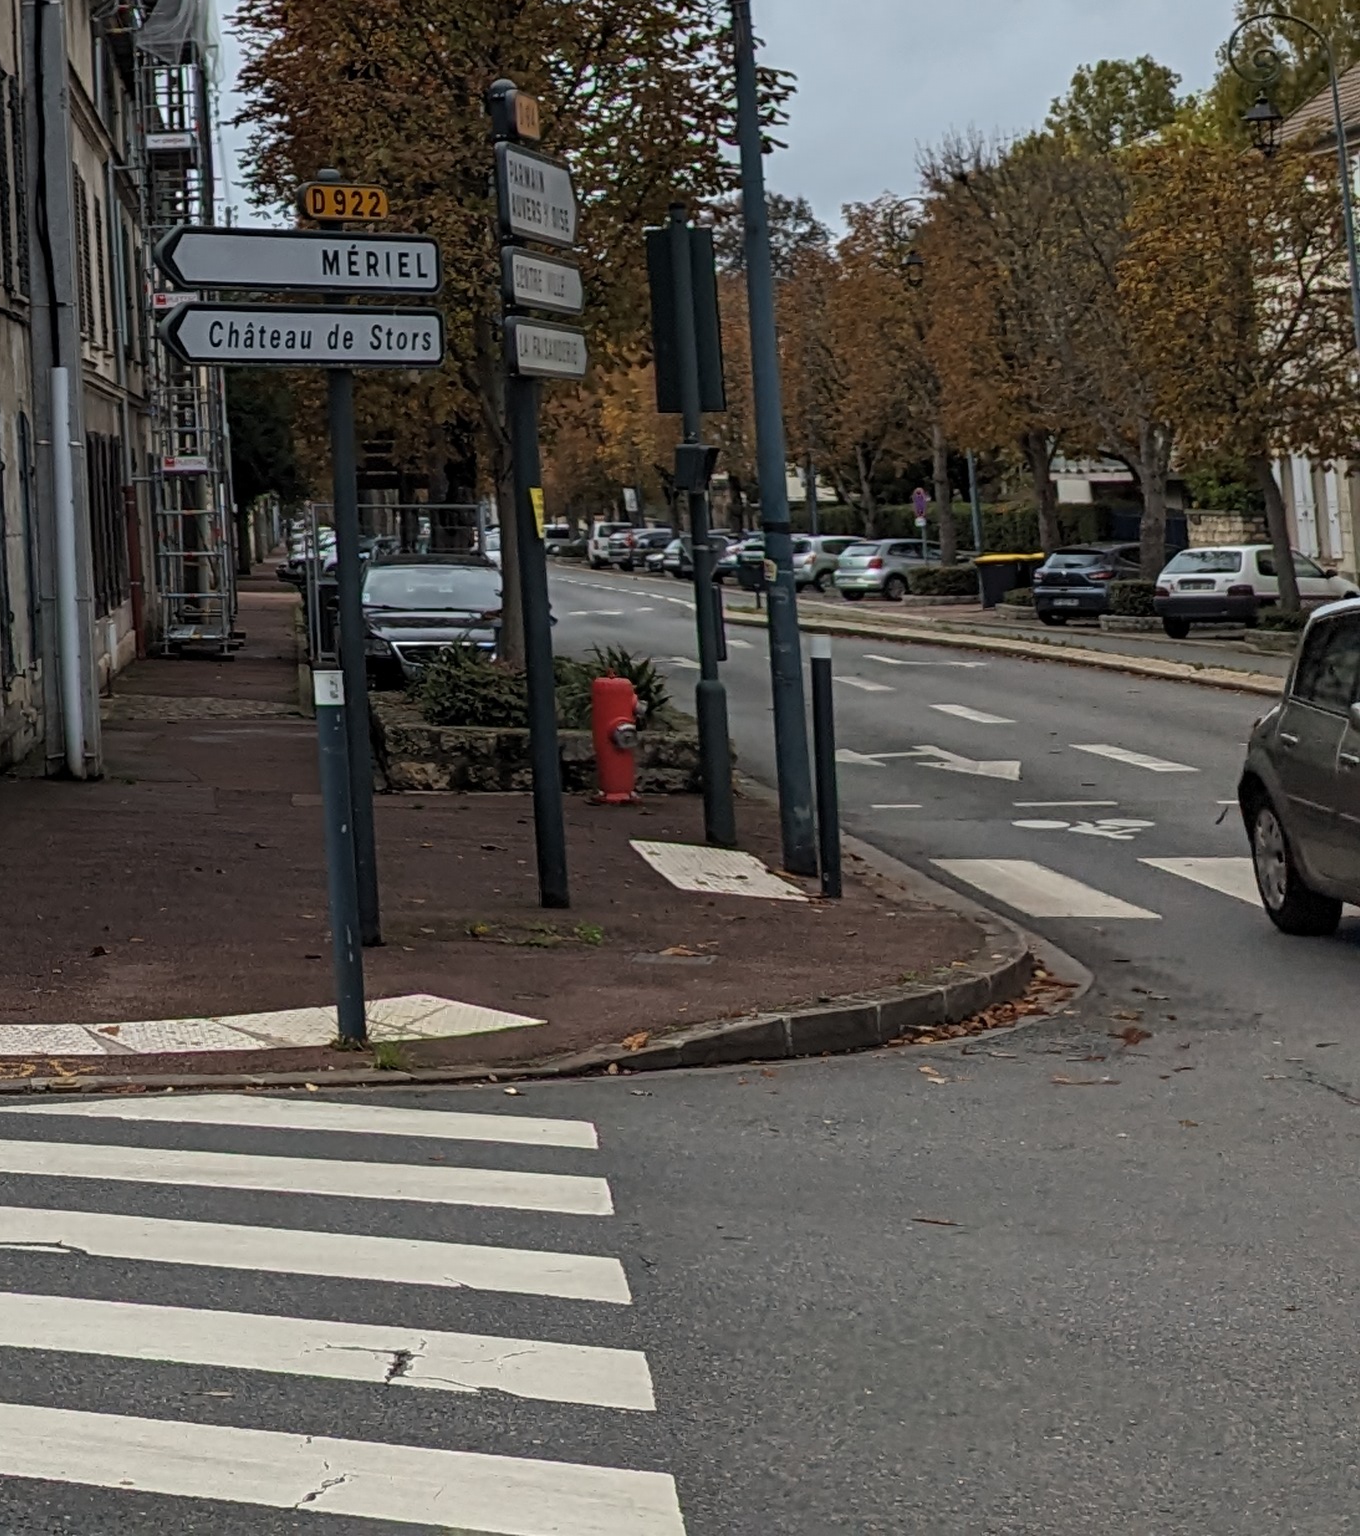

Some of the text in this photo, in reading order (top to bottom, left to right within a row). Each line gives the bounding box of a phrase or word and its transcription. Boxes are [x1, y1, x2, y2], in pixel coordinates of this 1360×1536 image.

[312, 188, 382, 218] D 922
[322, 244, 428, 279] MÉRIEL
[209, 320, 432, 352] Château de Stors
